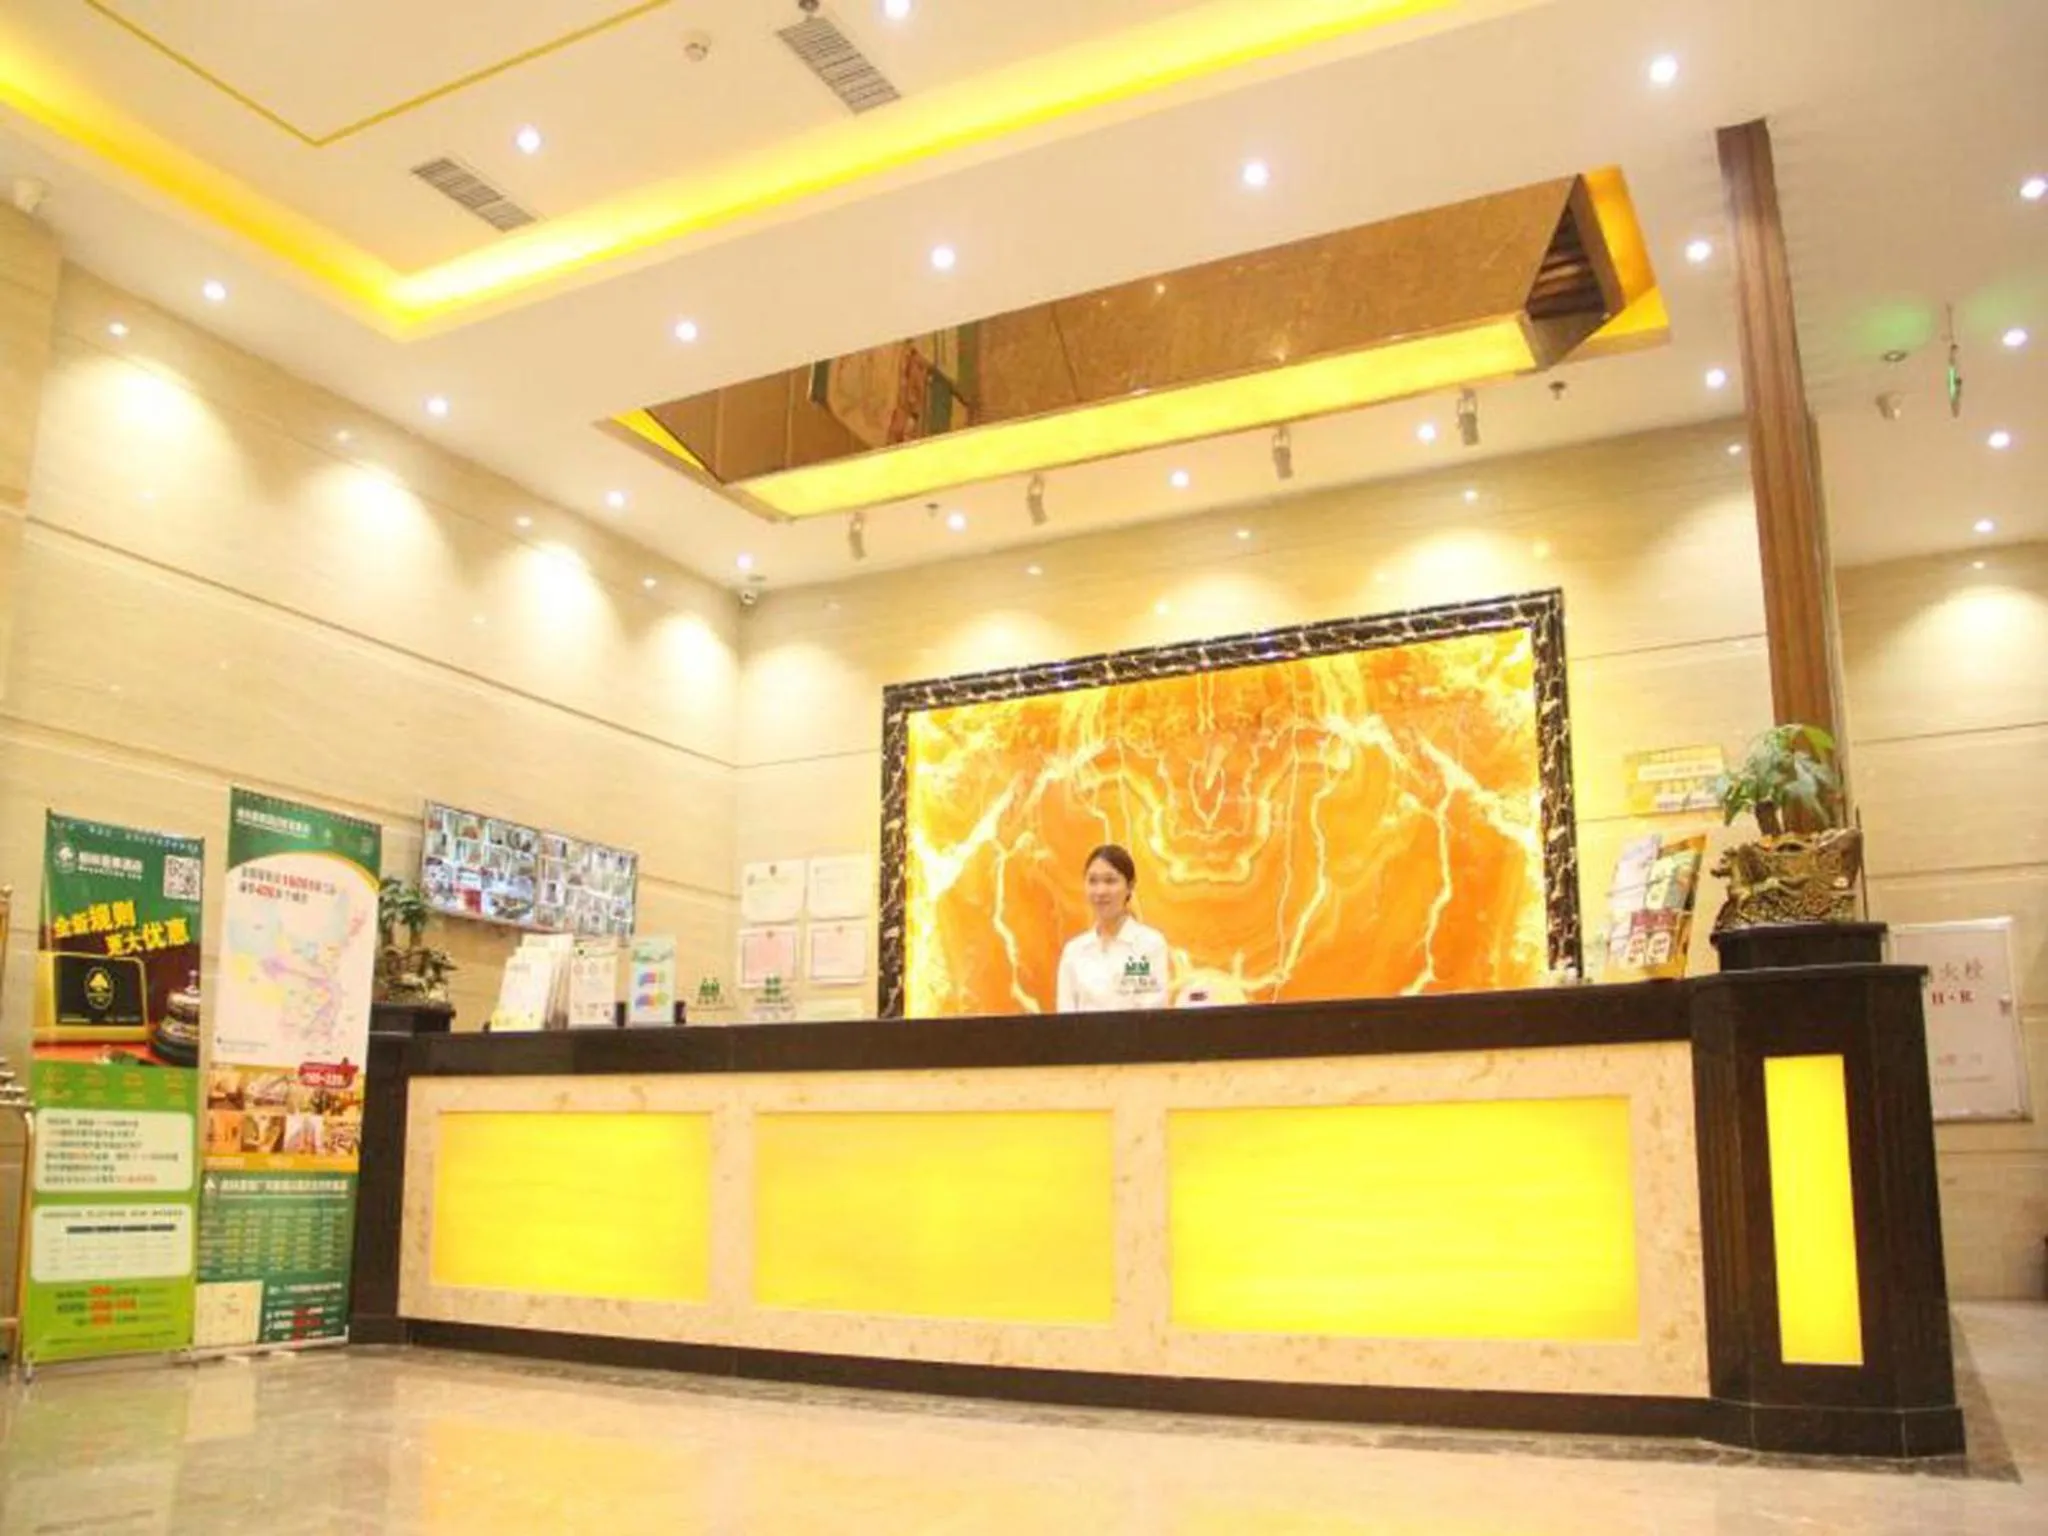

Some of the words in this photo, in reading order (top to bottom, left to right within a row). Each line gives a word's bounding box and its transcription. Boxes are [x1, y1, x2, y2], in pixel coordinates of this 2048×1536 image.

[54, 900, 135, 938] 全新规则
[105, 917, 190, 957] 更大优惠
[1929, 957, 1984, 981] 火栓
